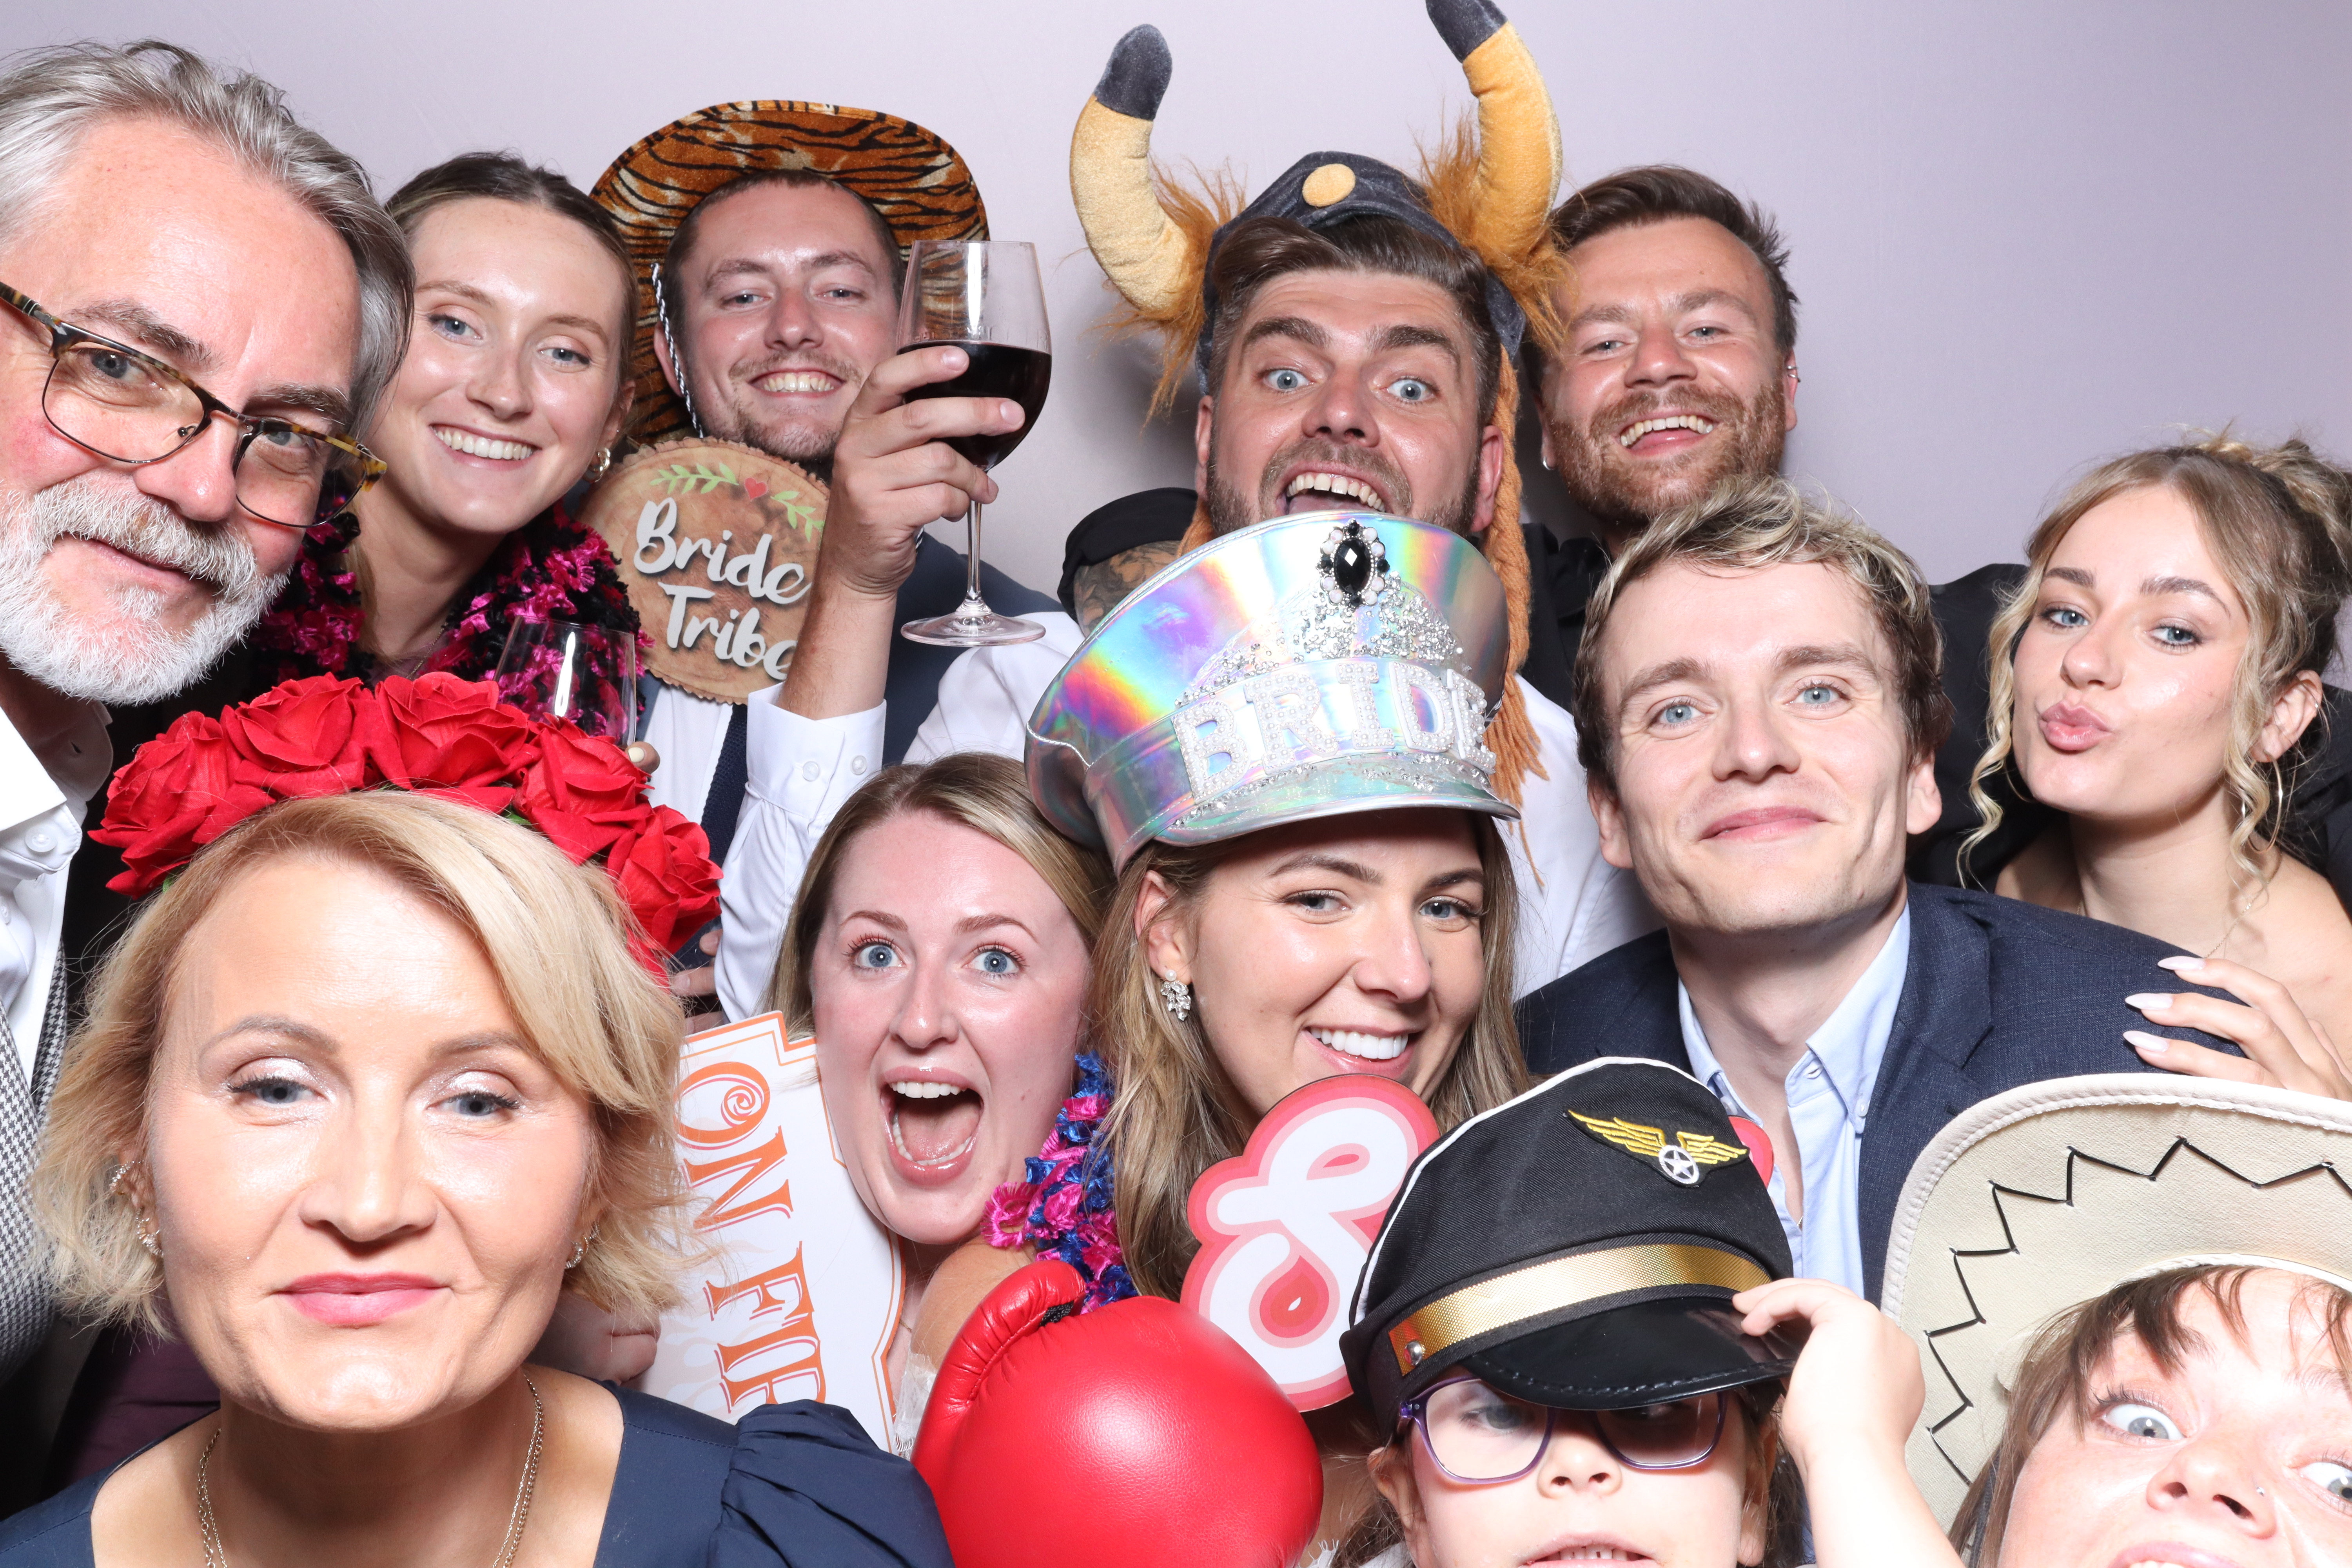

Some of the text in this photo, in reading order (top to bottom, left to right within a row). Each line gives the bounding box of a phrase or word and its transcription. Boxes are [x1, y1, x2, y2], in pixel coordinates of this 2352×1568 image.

[633, 497, 812, 604] Bride
[657, 582, 798, 680] Tribe
[1172, 661, 1496, 804] BRIDE
[674, 1062, 793, 1234] ON
